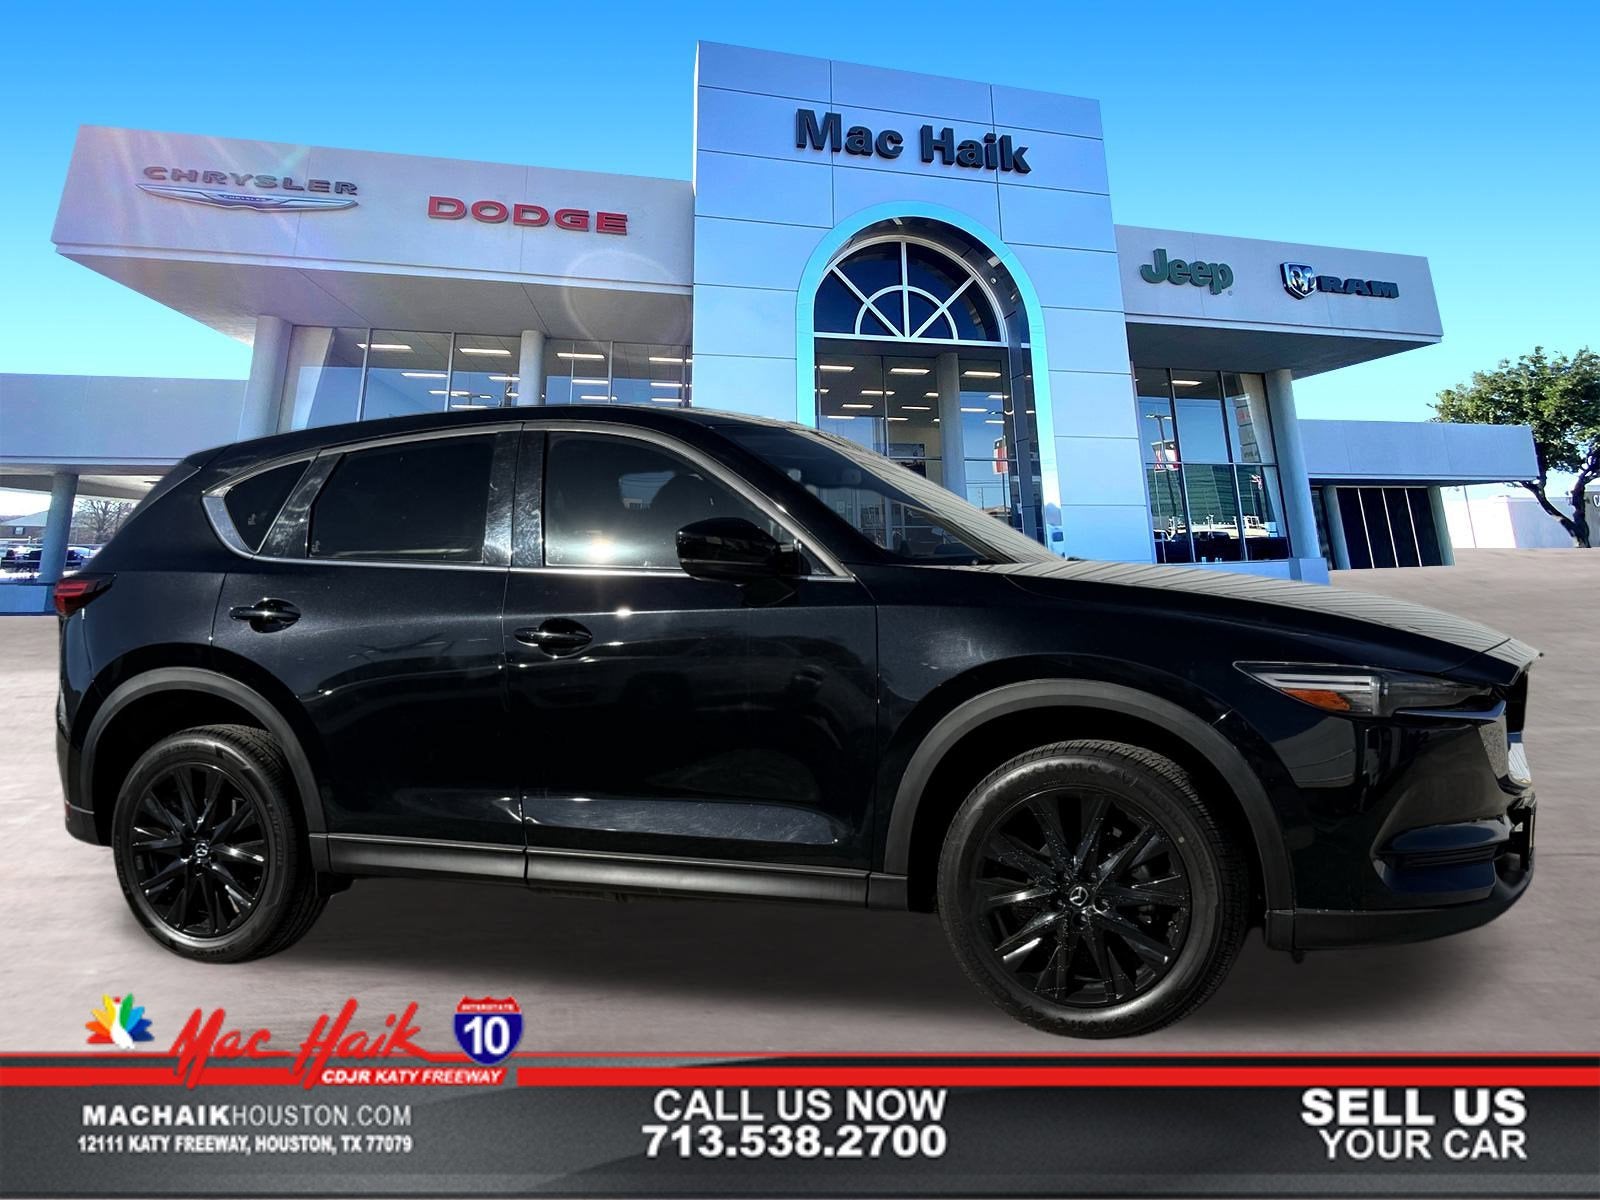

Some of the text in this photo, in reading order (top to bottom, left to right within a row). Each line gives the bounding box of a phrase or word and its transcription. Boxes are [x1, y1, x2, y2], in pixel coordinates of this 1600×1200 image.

[796, 108, 1031, 174] Mac Haik
[143, 165, 359, 197] CHRYSLER
[428, 196, 629, 236] DODGE
[1140, 248, 1234, 295] Jeep
[1315, 275, 1399, 299] RAM
